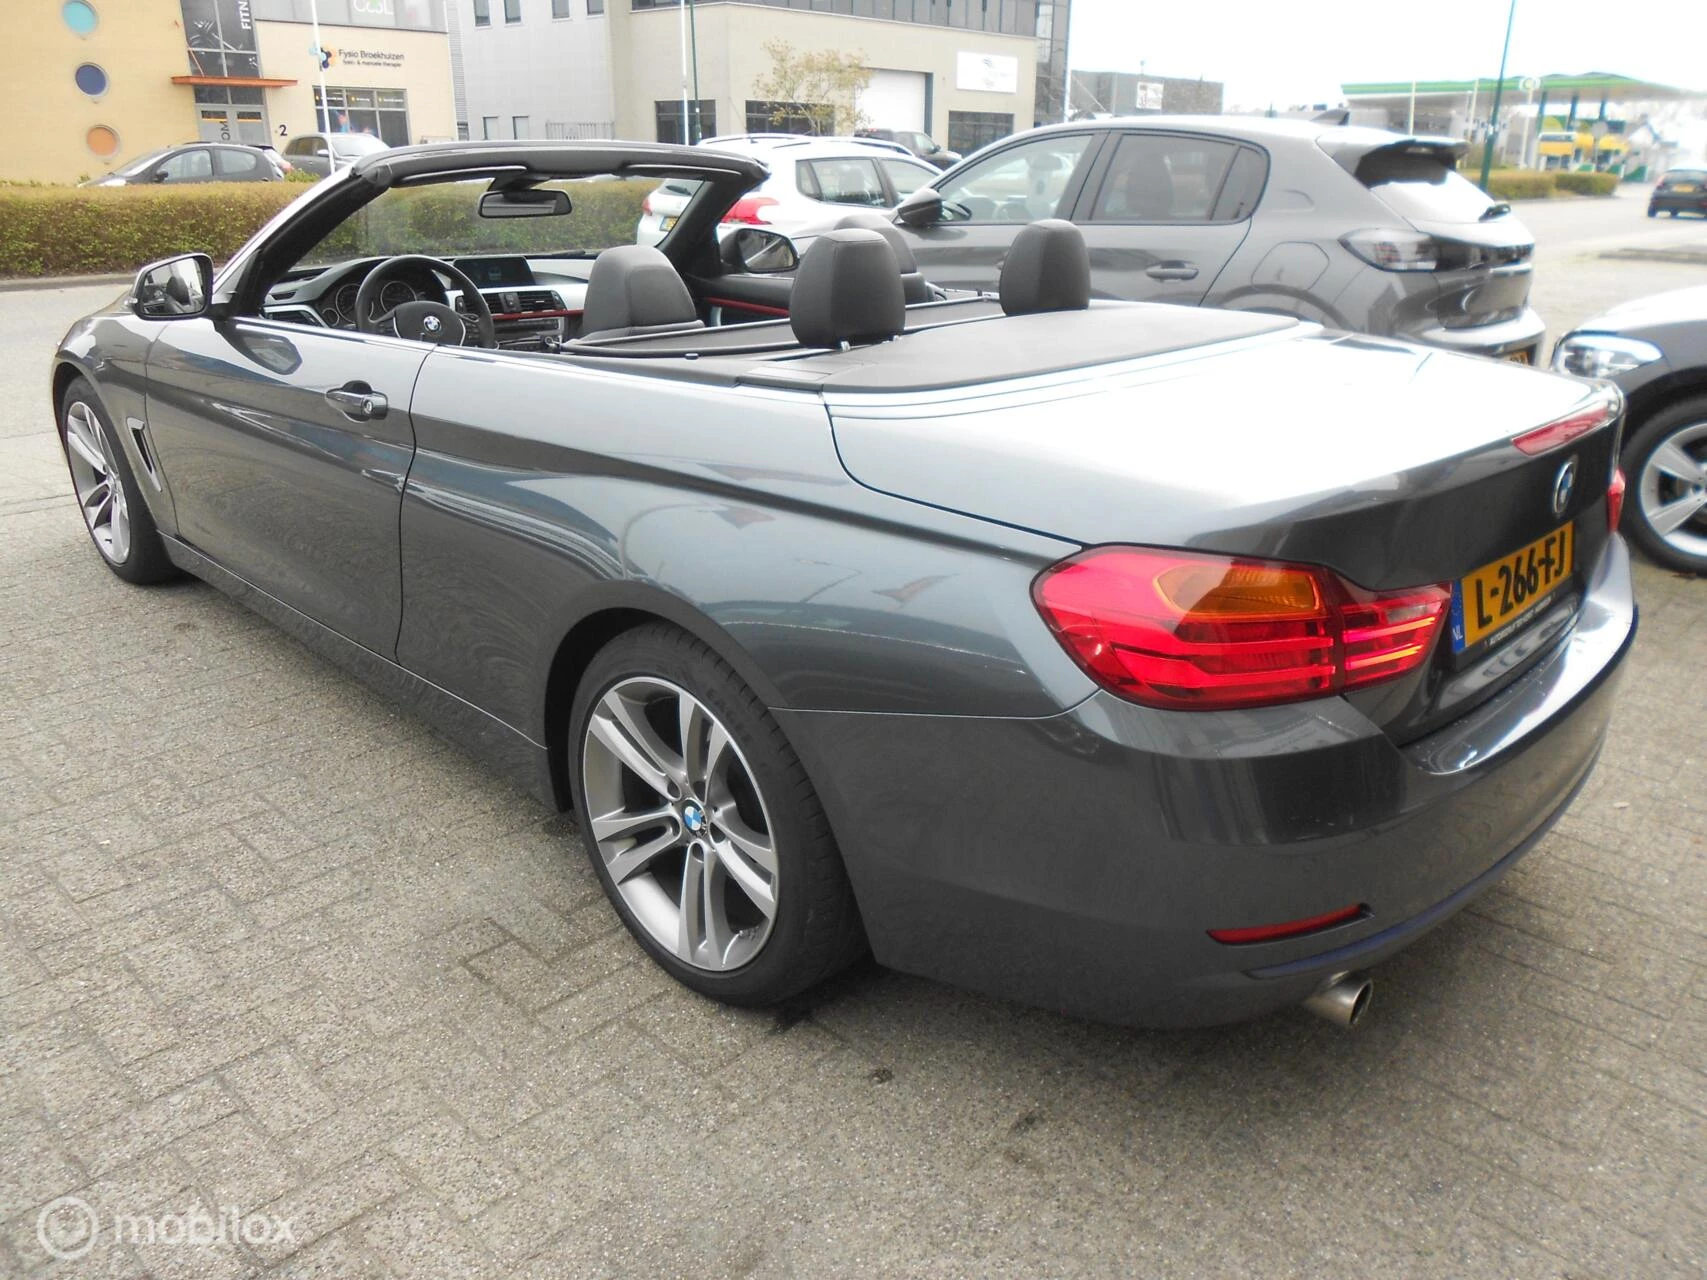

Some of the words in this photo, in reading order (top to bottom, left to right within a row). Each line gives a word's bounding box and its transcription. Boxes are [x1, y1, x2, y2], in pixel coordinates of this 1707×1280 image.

[338, 49, 359, 58] Fysio
[360, 50, 405, 60] Broekhuizen
[279, 124, 288, 136] 2
[1475, 531, 1566, 629] L-266-FJ
[1452, 624, 1464, 641] NL
